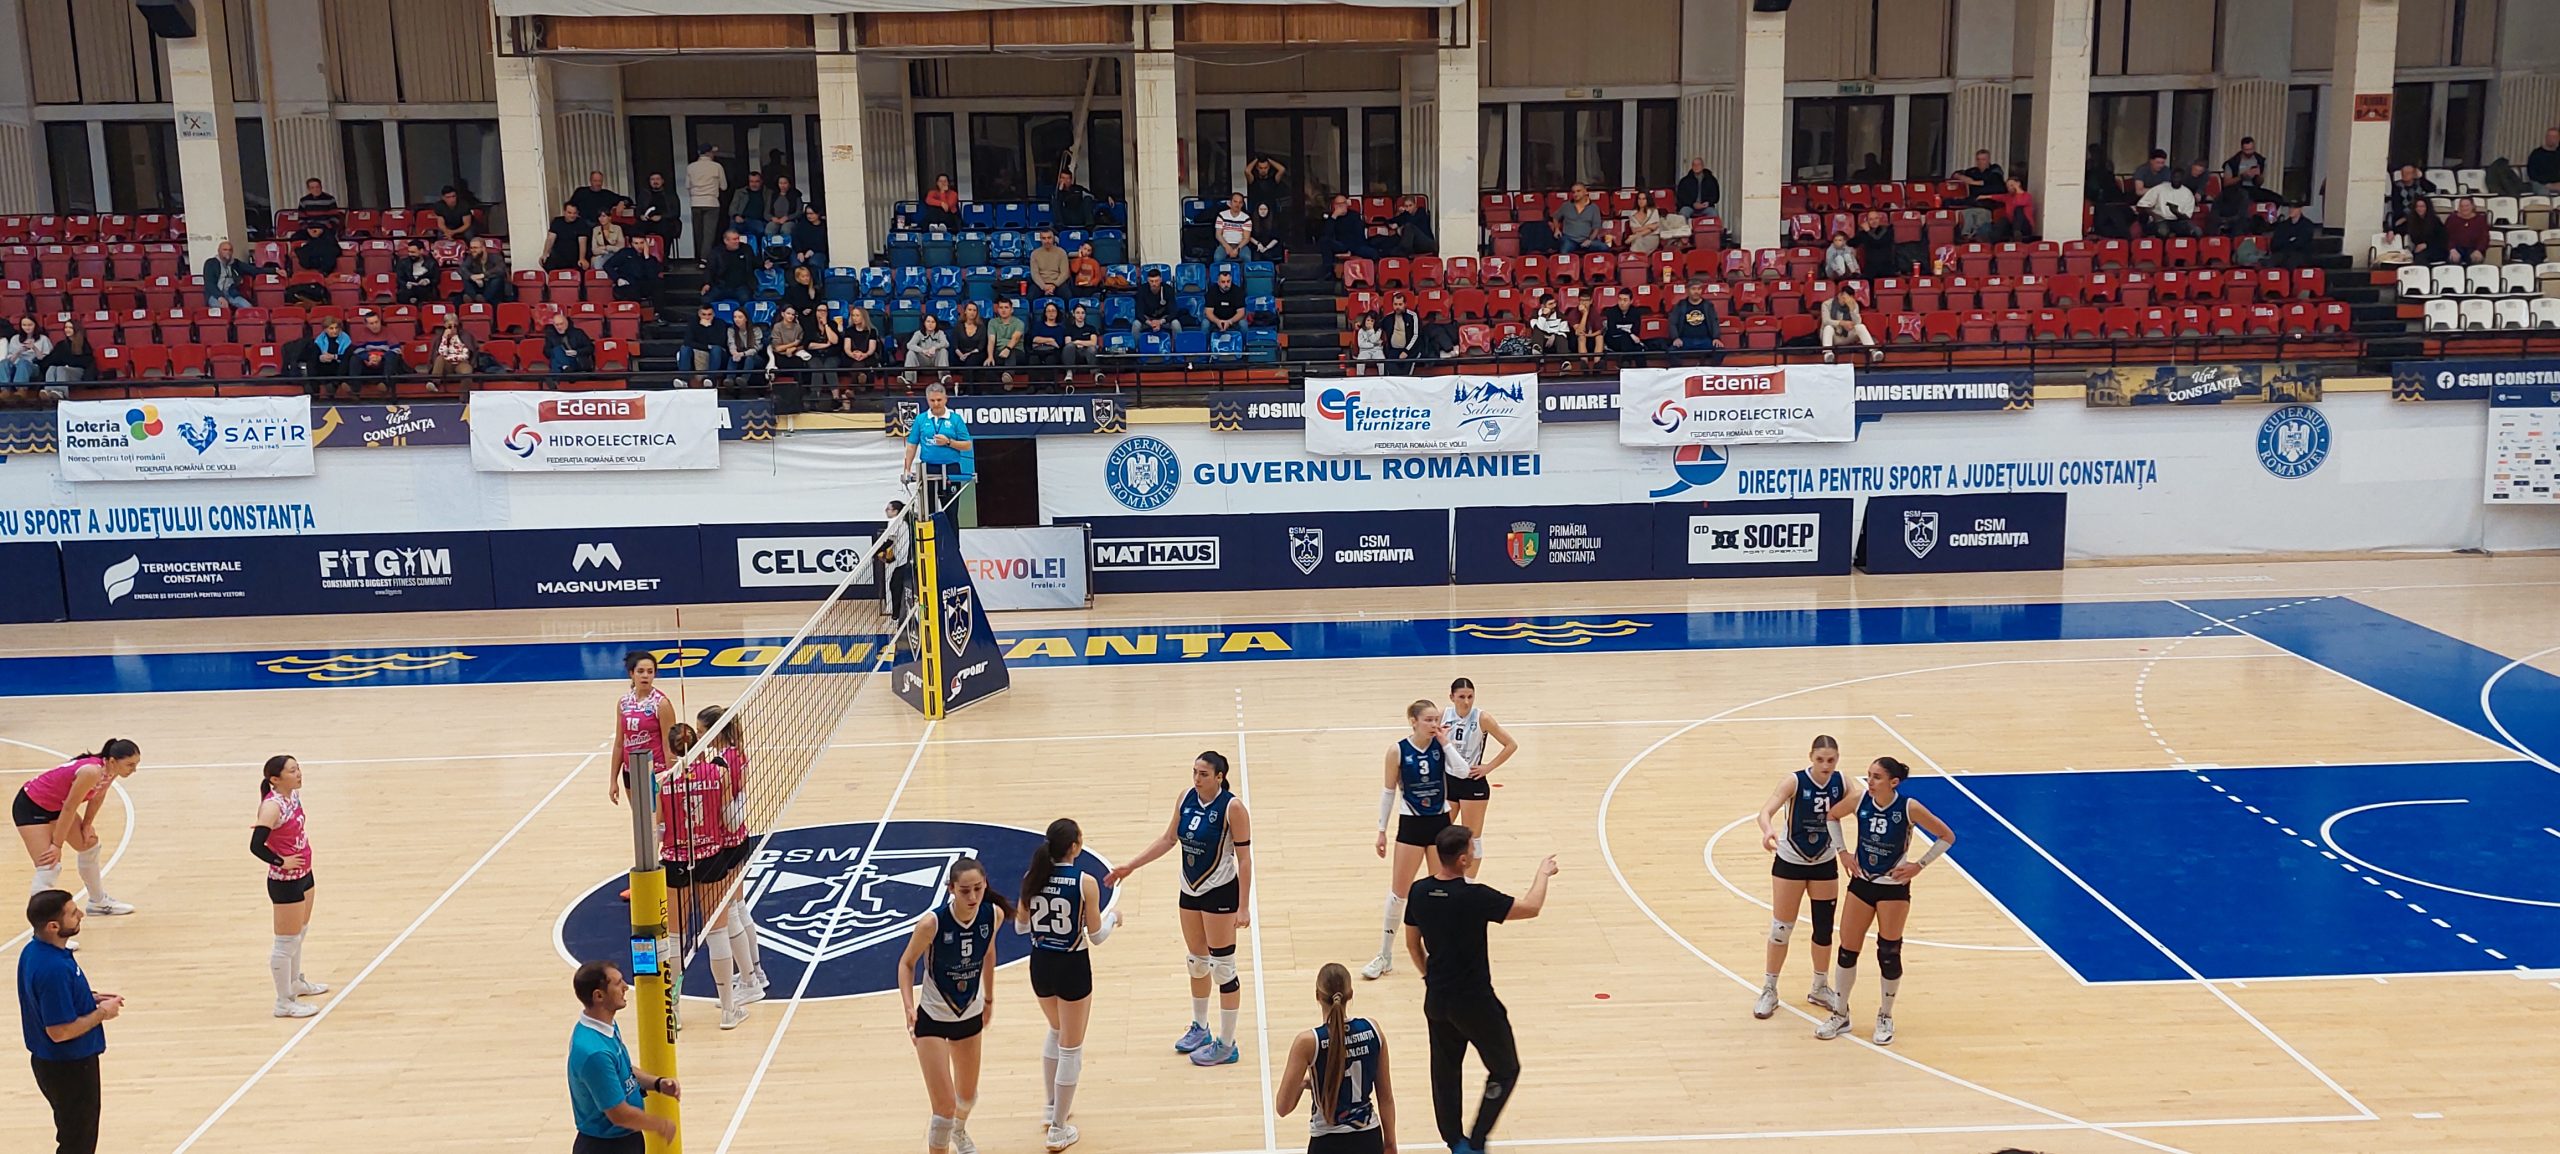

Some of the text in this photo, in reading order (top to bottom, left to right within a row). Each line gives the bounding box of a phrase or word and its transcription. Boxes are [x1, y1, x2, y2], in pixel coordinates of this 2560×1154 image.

[1702, 374, 1771, 392] Edenia
[2192, 367, 2218, 383] Visit
[2458, 373, 2492, 387] CSM
[2168, 376, 2242, 402] CONSTANȚA
[556, 400, 630, 416] Edenia
[1462, 402, 1514, 416] Salrom
[1560, 394, 1608, 410] MARE
[386, 408, 412, 424] Visit
[976, 406, 1086, 426] CONSTANȚA
[1355, 406, 1431, 419] electrica
[1693, 407, 1815, 422] HIDROELECTRICA
[2264, 408, 2326, 433] GUVERNUL
[66, 420, 120, 432] Loteria
[363, 418, 436, 442] CONSTANȚA
[1356, 419, 1432, 431] furnizare
[66, 434, 128, 448] Română
[224, 426, 304, 442] SAFIR
[548, 434, 676, 448] HIDROELECTRICA
[92, 455, 119, 463] pentru
[136, 452, 166, 461] românii
[1110, 439, 1174, 466] GUVERNUL
[1194, 453, 1541, 486] GUVERNUL ROMÂNIEI
[1738, 459, 2158, 498] DIRECȚIA PENTRU SPORT A JUDEȚULUI CONSTANȚA
[25, 509, 82, 535] SPORT
[88, 509, 100, 534] A
[106, 506, 202, 538] JUDEȚULUI
[208, 504, 316, 534] CONSTANȚA
[1550, 522, 1588, 536] PRIMĂRIA
[1974, 518, 2006, 532] CSM
[1288, 526, 1306, 534] CSM
[1744, 523, 1814, 548] SOCEP
[1359, 534, 1390, 548] CSM
[1549, 537, 1602, 550] MUNICIPIULUI
[1950, 532, 2030, 548] CONSTANȚA
[319, 547, 452, 578] FIT GYM
[752, 548, 860, 574] CELCO
[1335, 548, 1414, 564] CONSTANȚA
[1549, 551, 1596, 564] CONSTANȚA
[142, 561, 242, 574] TERMOCENTRALE
[966, 558, 1066, 580] FRVOLEI
[163, 574, 224, 584] CONSTANȚA
[322, 577, 452, 588] CONSTANTA'S BIGGEST FITNESS COMMUNITY
[537, 578, 661, 594] MAGNUMBET
[942, 586, 956, 600] CSM
[626, 717, 640, 732] 18
[1456, 728, 1464, 741] 6
[1418, 760, 1430, 775] 3
[1814, 796, 1831, 813] 21
[1188, 816, 1202, 831] 9
[1869, 817, 1888, 835] 13
[757, 847, 861, 863] CSM
[1030, 896, 1072, 935] 23
[961, 938, 973, 957] 5
